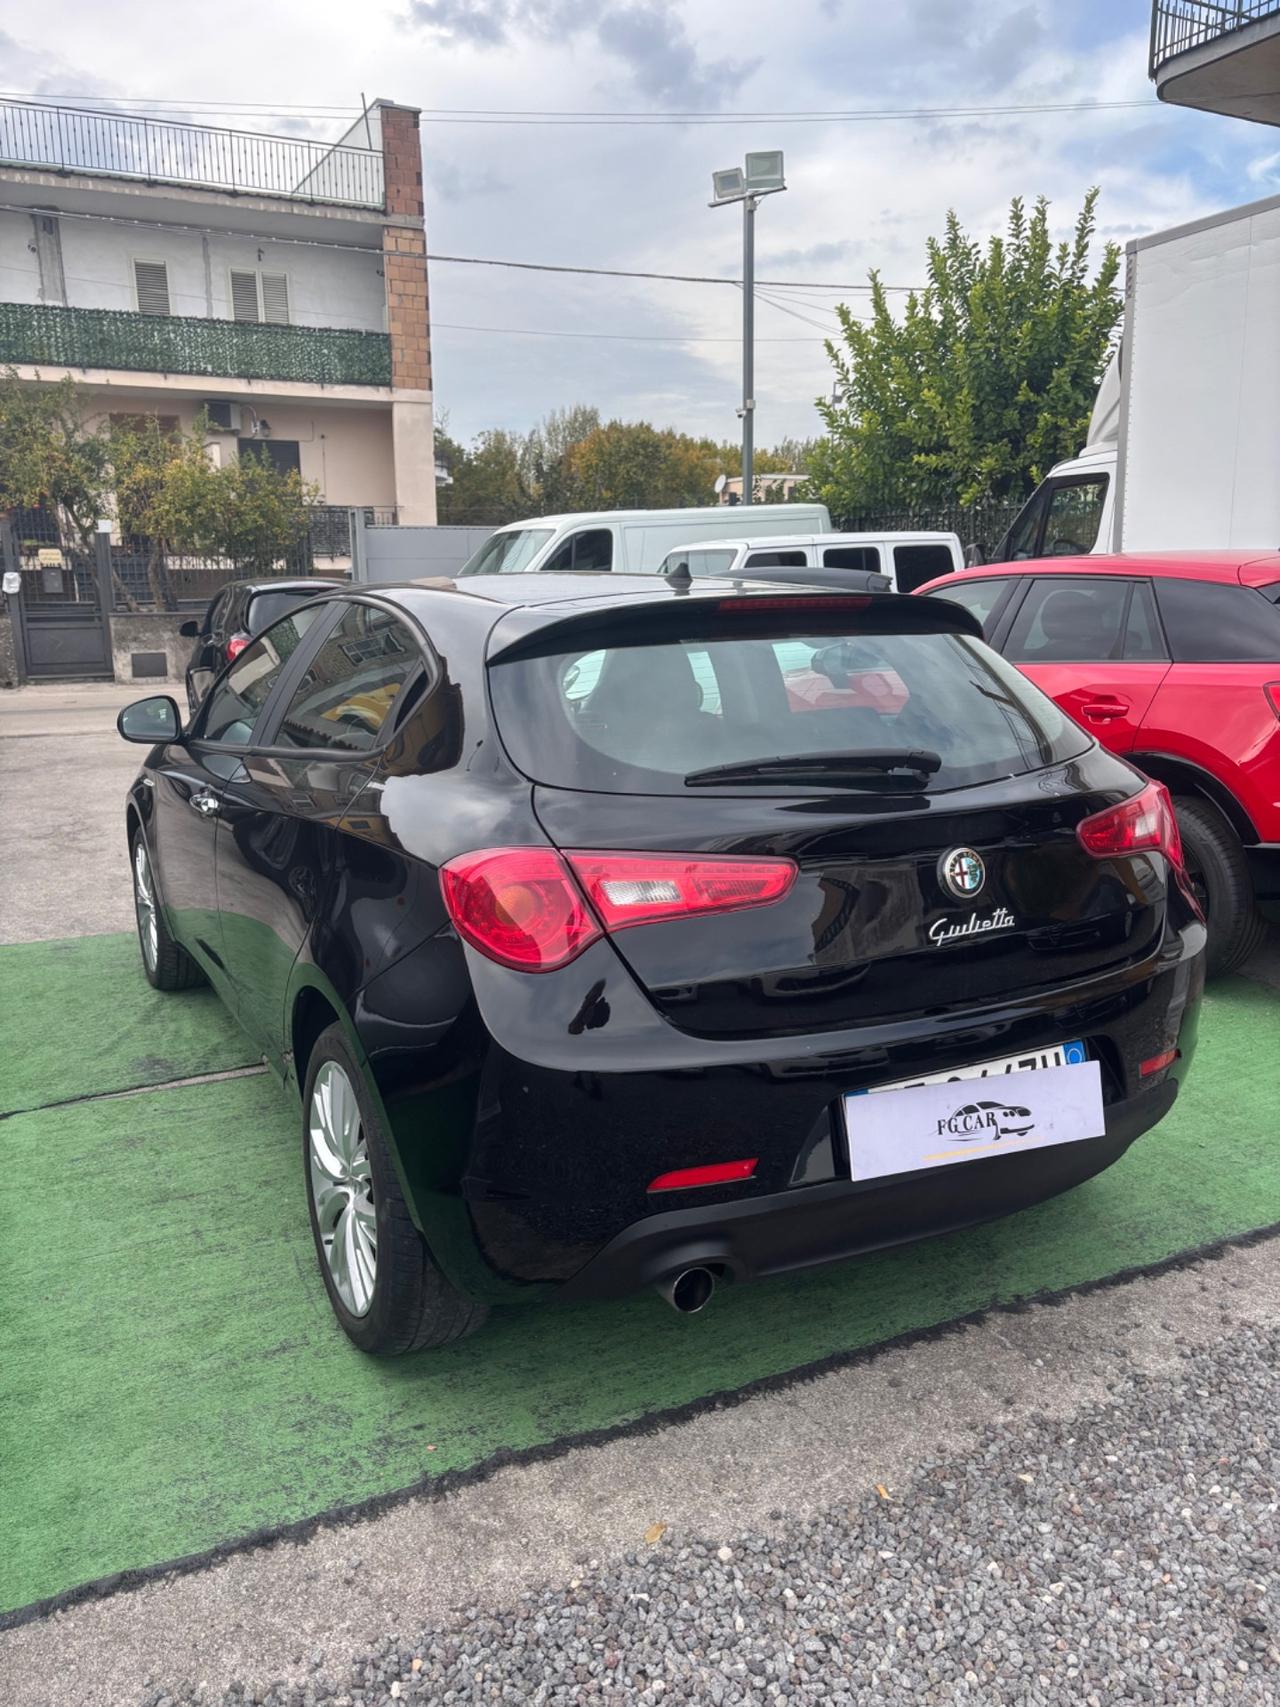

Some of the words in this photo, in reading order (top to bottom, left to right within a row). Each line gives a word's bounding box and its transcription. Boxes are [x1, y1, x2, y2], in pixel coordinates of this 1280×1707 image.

[929, 907, 1015, 946] Giulietta
[937, 1118, 959, 1135] FG
[963, 1112, 999, 1134] CAR
